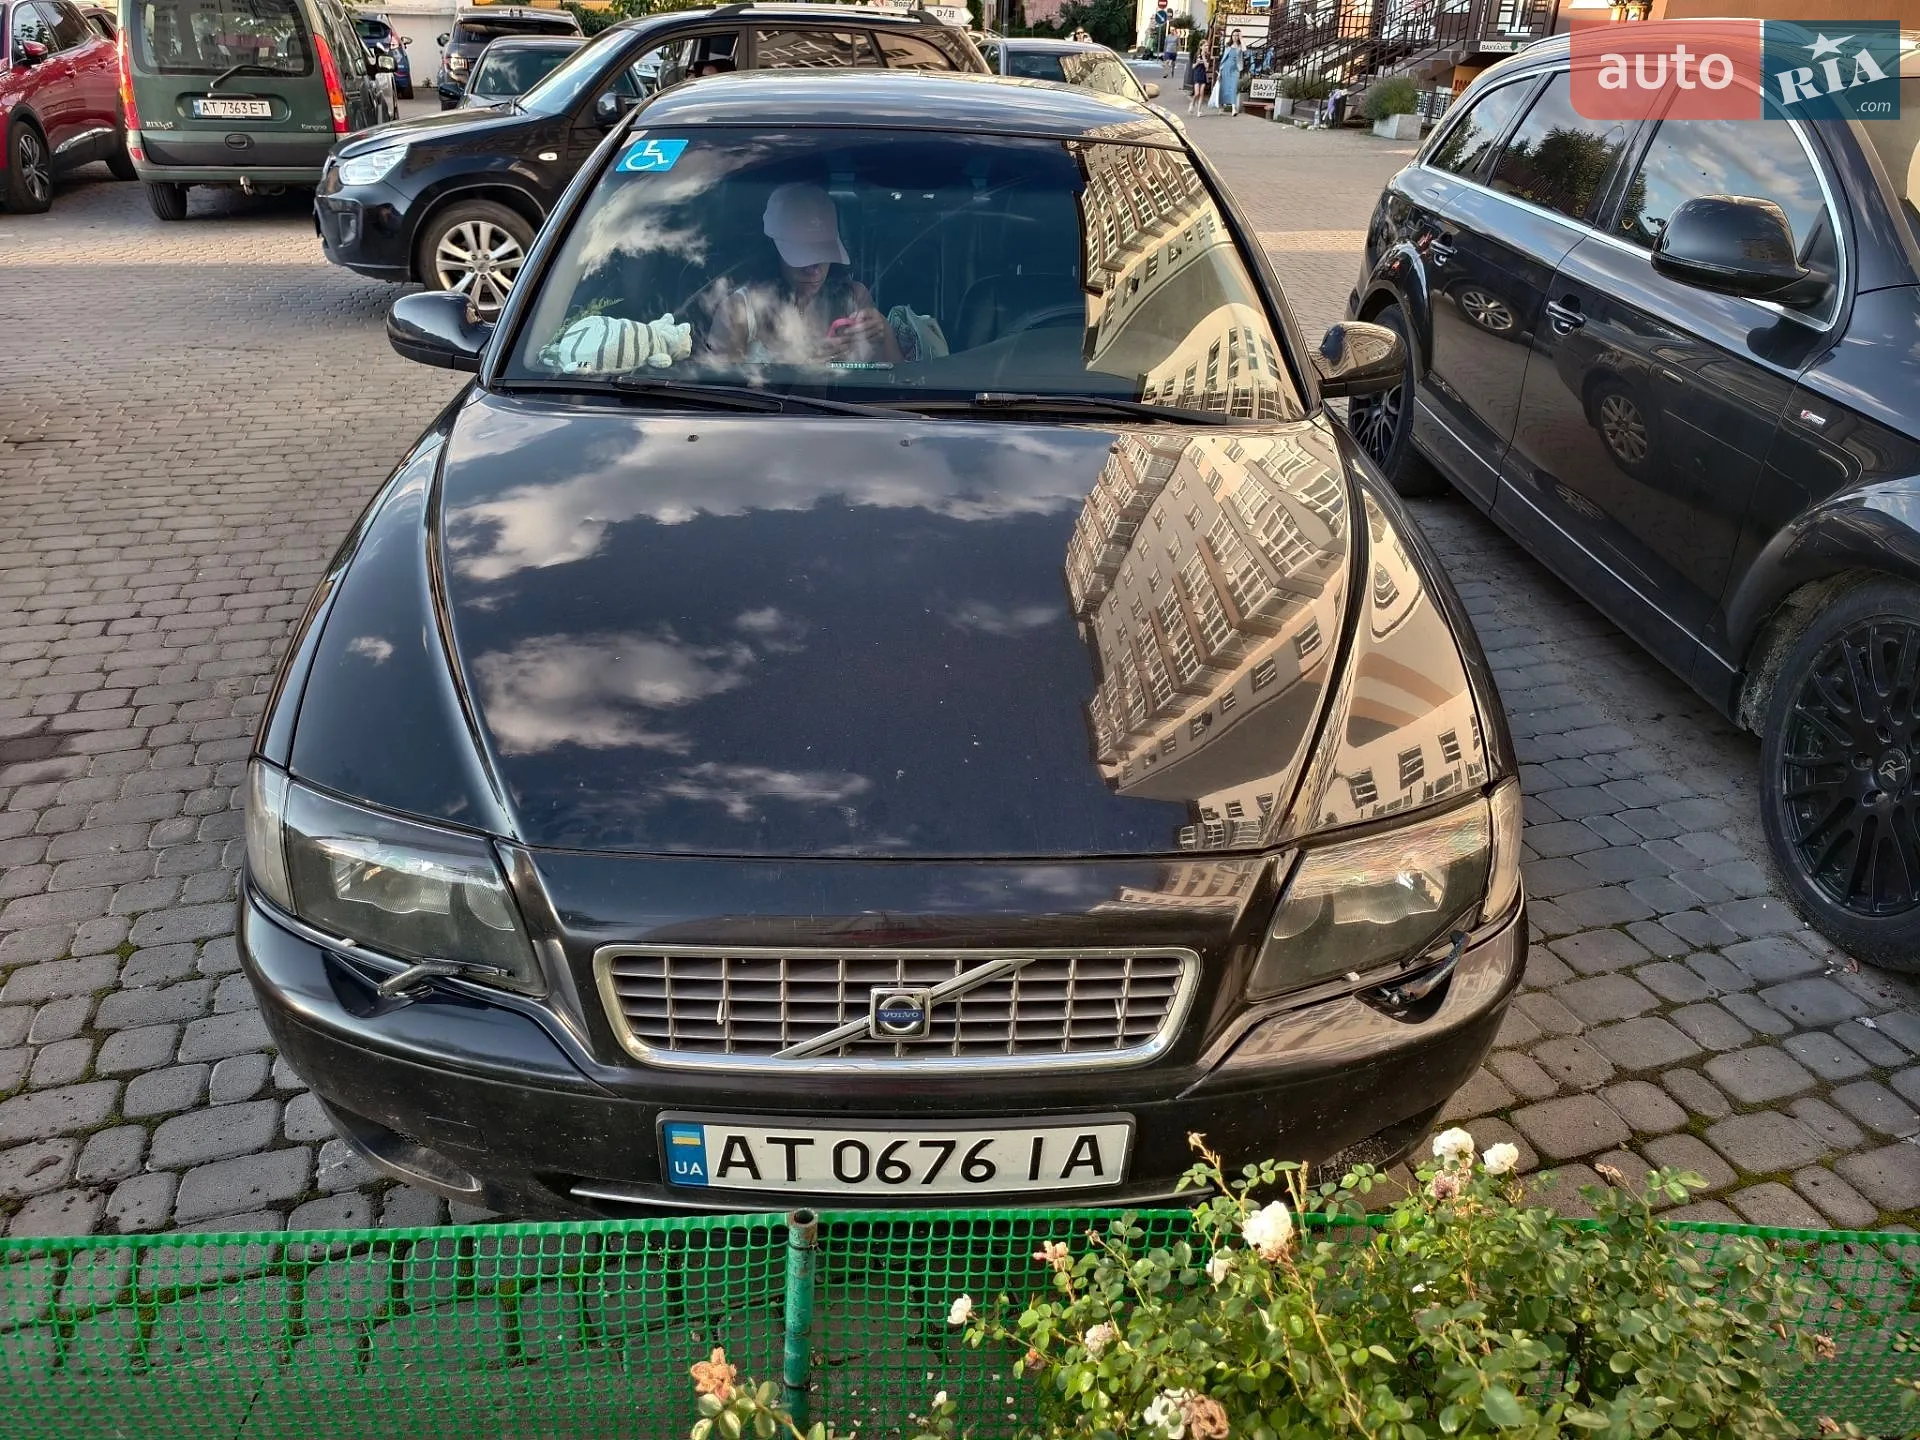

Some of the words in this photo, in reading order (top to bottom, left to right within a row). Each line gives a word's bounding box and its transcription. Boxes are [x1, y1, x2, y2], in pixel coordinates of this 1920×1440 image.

[202, 102, 217, 115] AT
[220, 102, 247, 114] 7363
[250, 102, 266, 114] ET
[715, 1134, 814, 1182] AT
[832, 1138, 997, 1185] 0676
[1028, 1133, 1105, 1181] IA
[674, 1160, 703, 1176] UA
